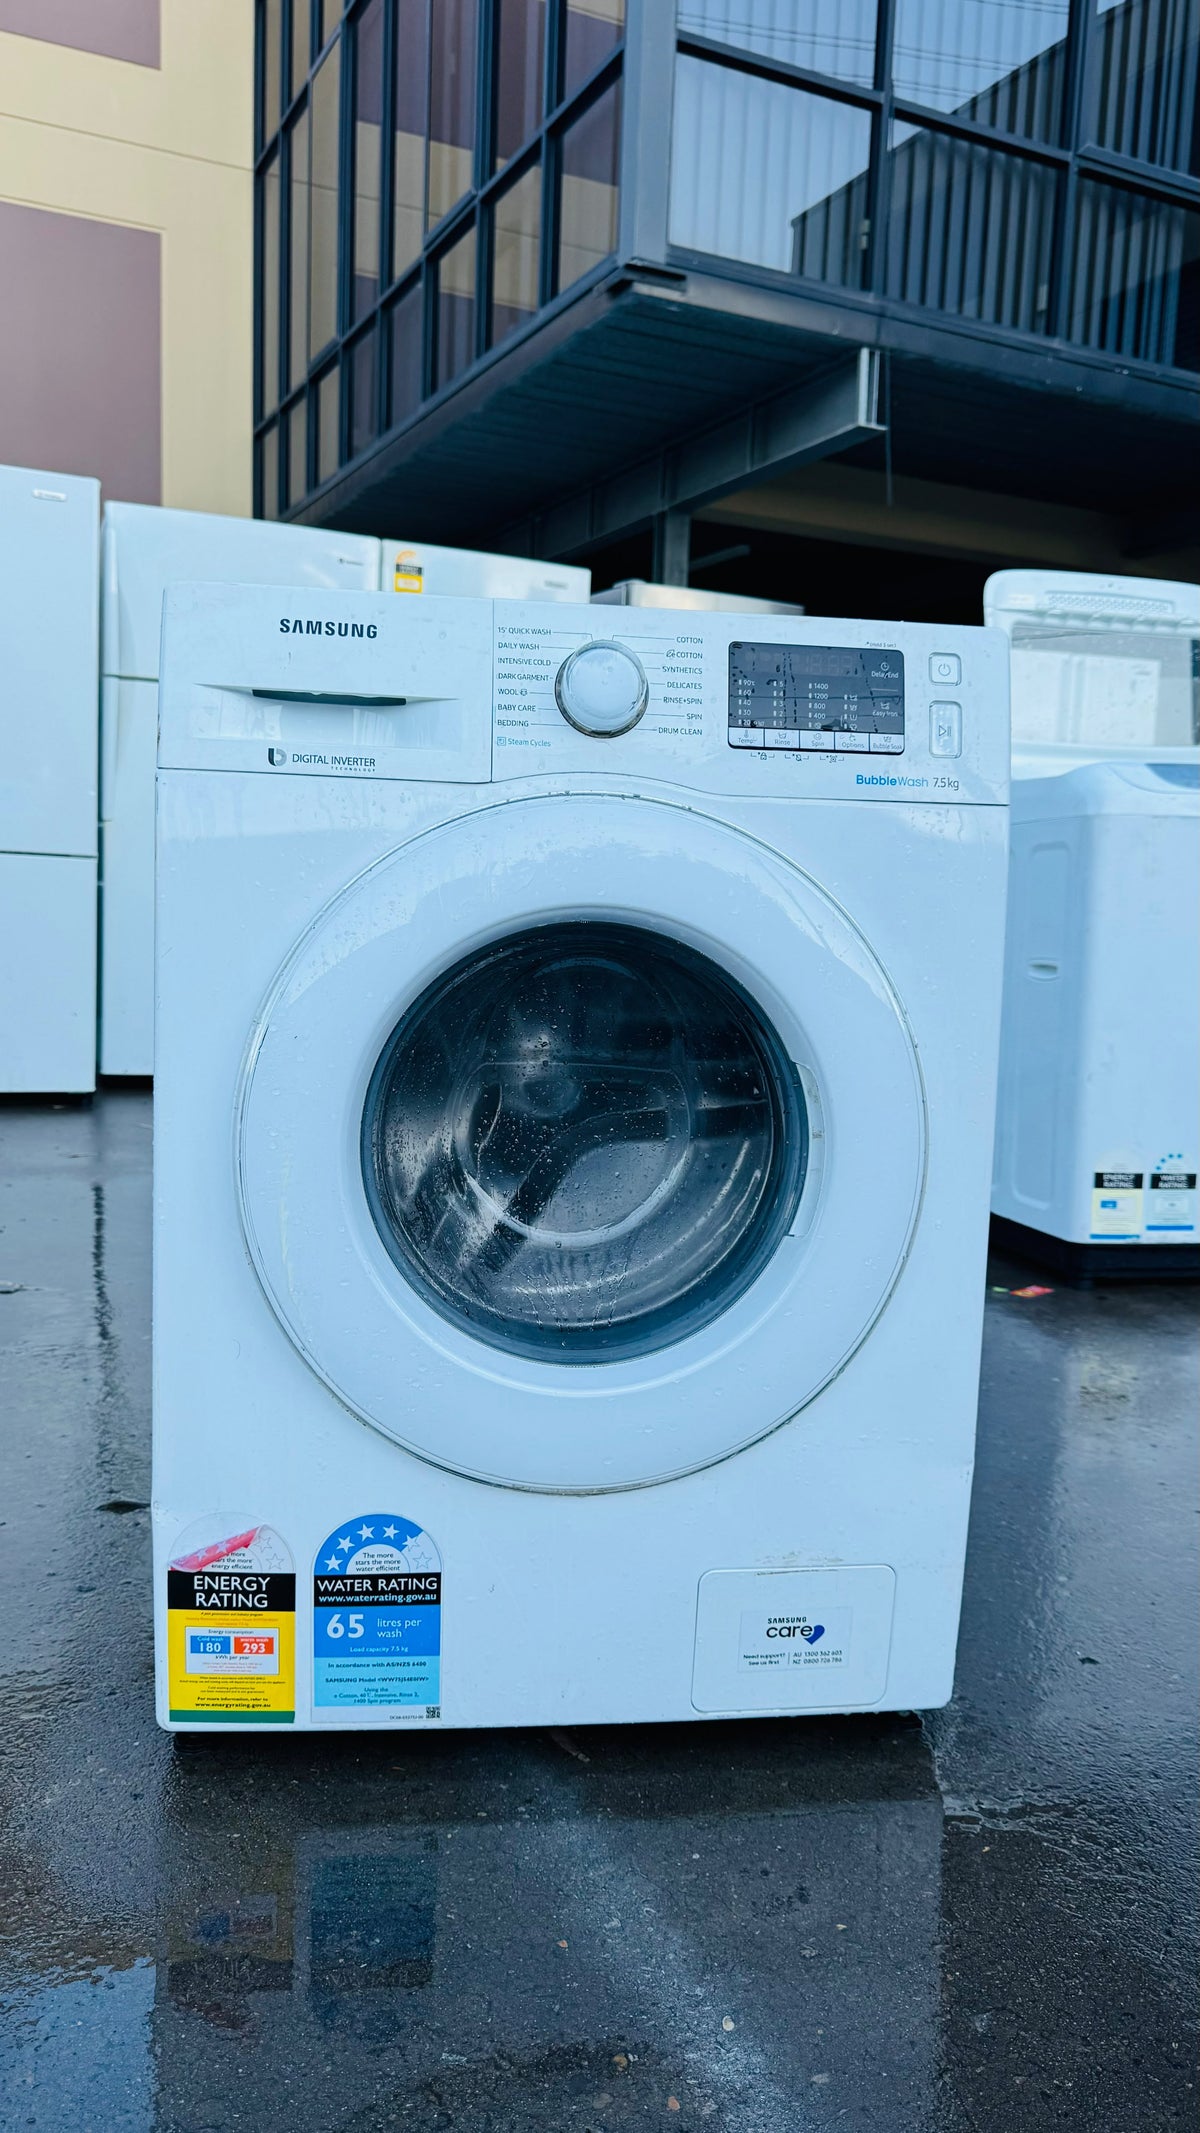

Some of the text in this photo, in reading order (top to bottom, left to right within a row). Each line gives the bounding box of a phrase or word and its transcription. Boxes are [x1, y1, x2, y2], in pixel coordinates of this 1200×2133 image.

[279, 618, 378, 639] SAMSUNG
[662, 666, 703, 674] SYNTHETICS
[667, 681, 702, 690] DELICATES
[663, 696, 703, 705] RINSE+SPIN
[530, 739, 551, 747] Cycles
[292, 754, 376, 767] DIGITAL INVERTER
[194, 1575, 271, 1591] ENERGY
[317, 1577, 438, 1592] WATER RATING
[196, 1592, 268, 1608] RATING
[318, 1593, 437, 1603] www.waterrating.gov.au
[377, 1618, 422, 1629] litres per
[767, 1616, 807, 1624] SAMSUNG
[326, 1613, 365, 1639] 65
[377, 1629, 402, 1638] wash
[766, 1625, 813, 1638] care
[200, 1643, 221, 1652] 180
[242, 1643, 266, 1653] 293
